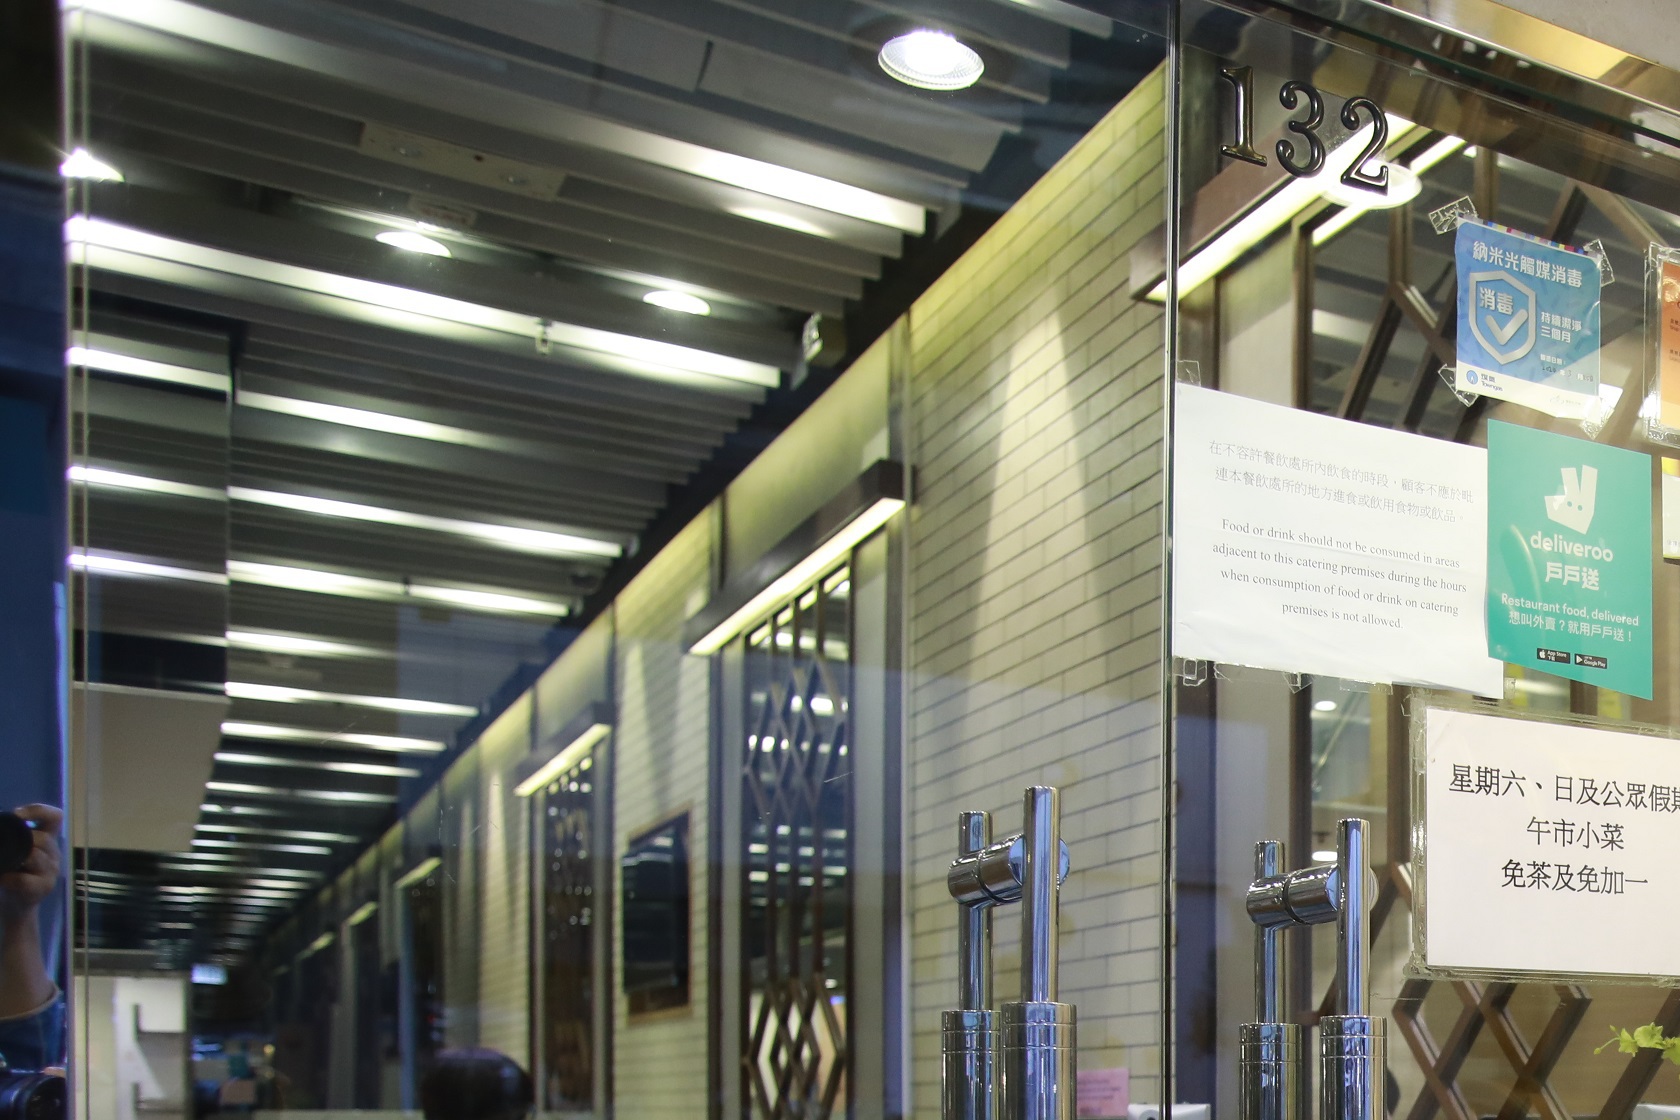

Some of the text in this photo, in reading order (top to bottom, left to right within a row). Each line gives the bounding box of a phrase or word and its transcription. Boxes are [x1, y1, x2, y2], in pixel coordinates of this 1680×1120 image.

[1219, 65, 1389, 196] 132
[1472, 240, 1583, 289] 納米光觸媒消毒
[1479, 287, 1515, 316] 消毒
[1541, 326, 1571, 344] 三個月
[1222, 519, 1460, 568] Food or drink should not be consumed in areas
[1530, 531, 1614, 562] deliveroo
[1212, 543, 1467, 593] adjacent to this catering premises during the hours
[1545, 562, 1600, 591] 戶戶送
[1220, 568, 1459, 617] when consumption of food or drink on catering
[1501, 593, 1639, 626] Restaurant food, delivered
[1282, 602, 1404, 629] premises is not allowed.
[1526, 816, 1625, 851] 午市小菜
[1501, 858, 1648, 894] 免茶及免加一
